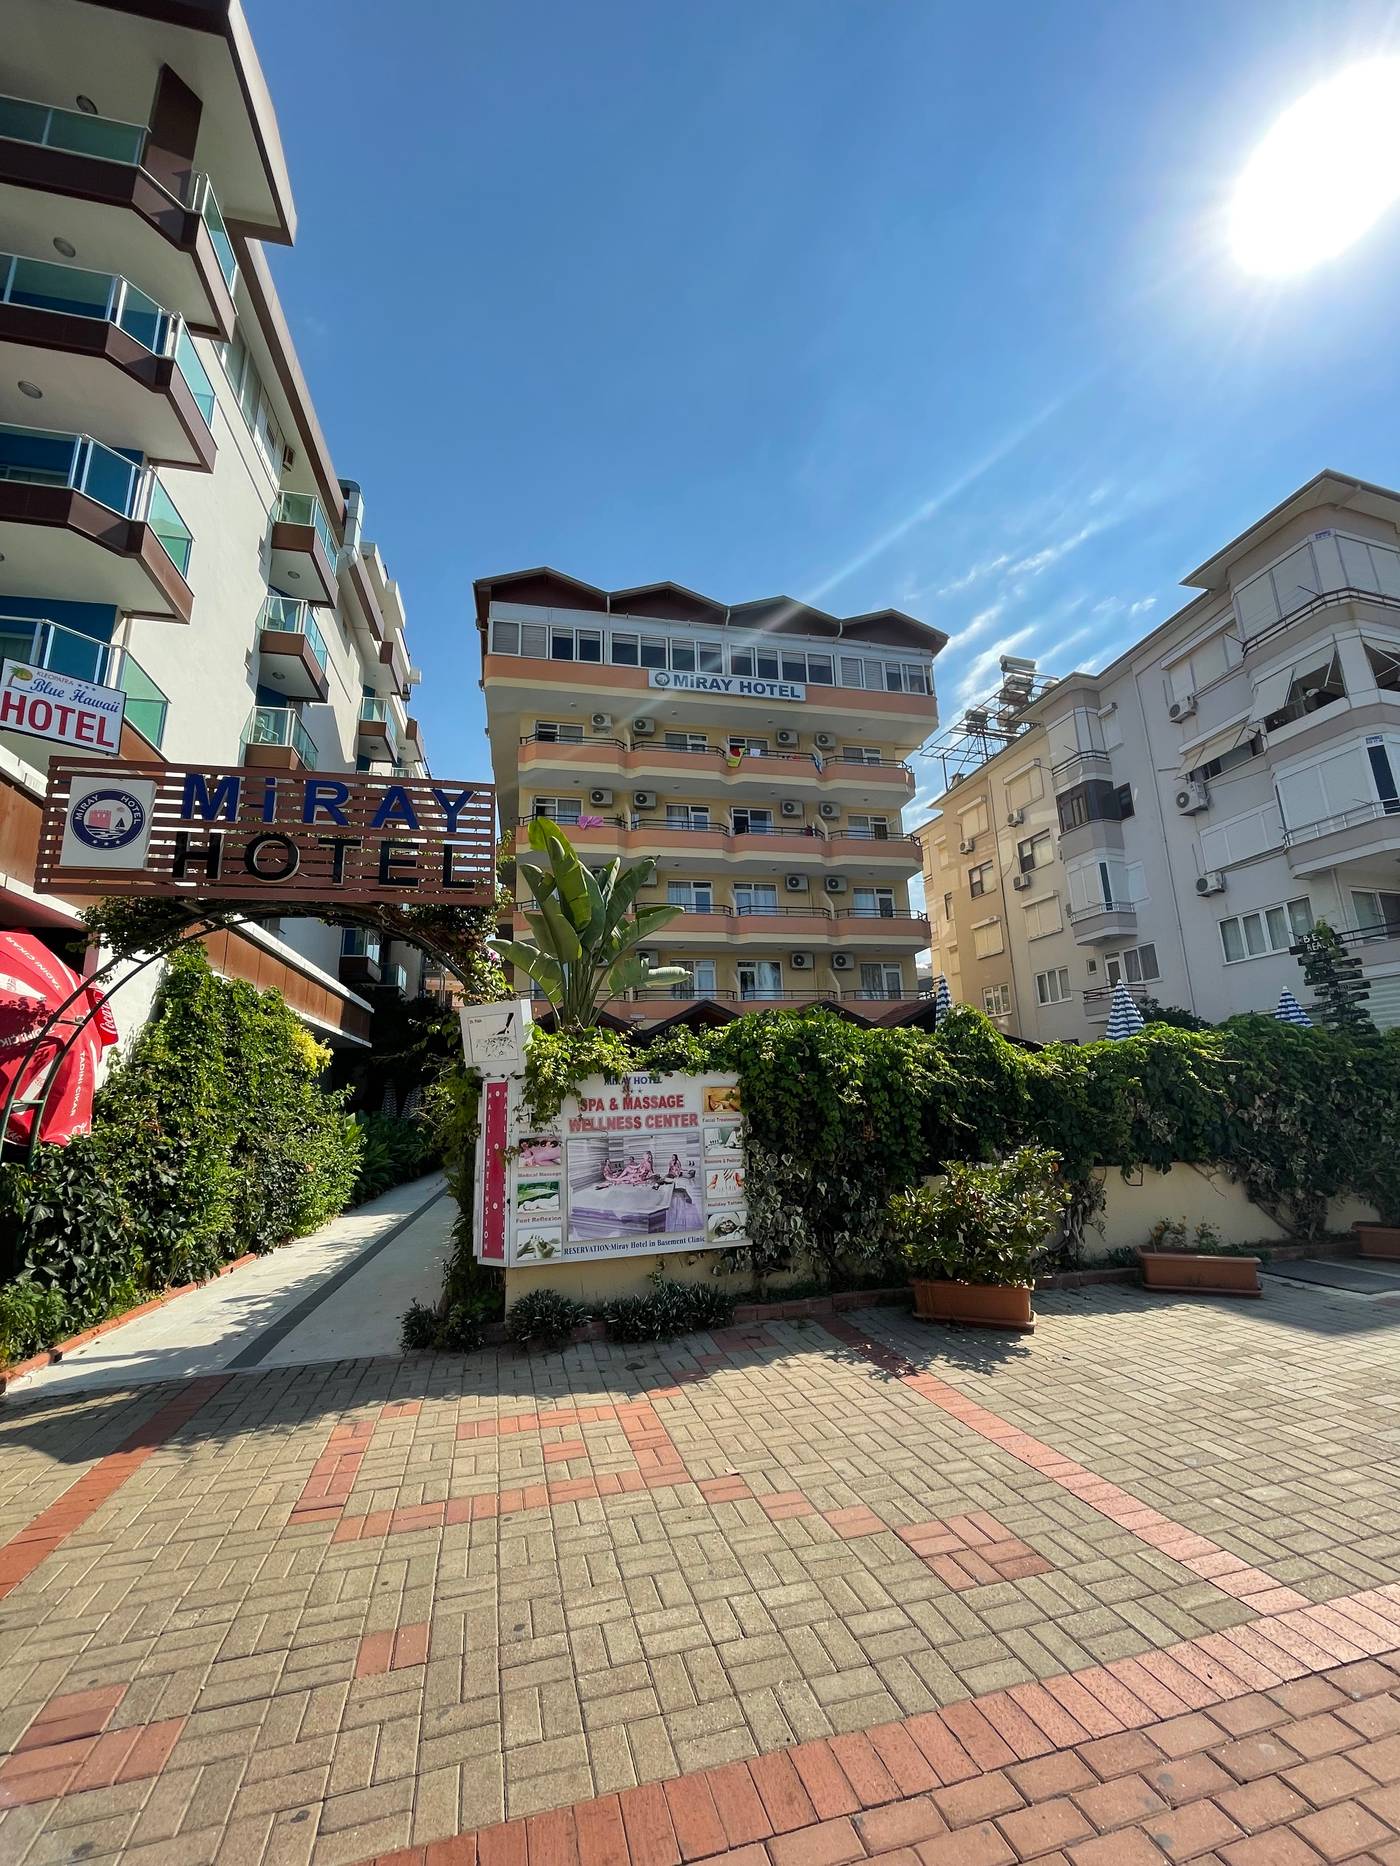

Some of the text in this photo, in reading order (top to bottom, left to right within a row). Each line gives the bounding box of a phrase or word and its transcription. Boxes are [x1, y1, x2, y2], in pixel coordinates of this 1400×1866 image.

[36, 671, 74, 686] KLEOPATRA
[30, 679, 120, 713] Blue Hawaii
[739, 680, 801, 699] HOTEL
[0, 690, 114, 748] HOTEL
[120, 795, 142, 825] HOTEL
[171, 831, 476, 890] HOTEL
[580, 1094, 684, 1112] SPA & MASSAGE
[568, 1113, 698, 1133] WELLNESS CENTER
[631, 1241, 648, 1249] Hotel
[657, 1238, 686, 1246] Basement
